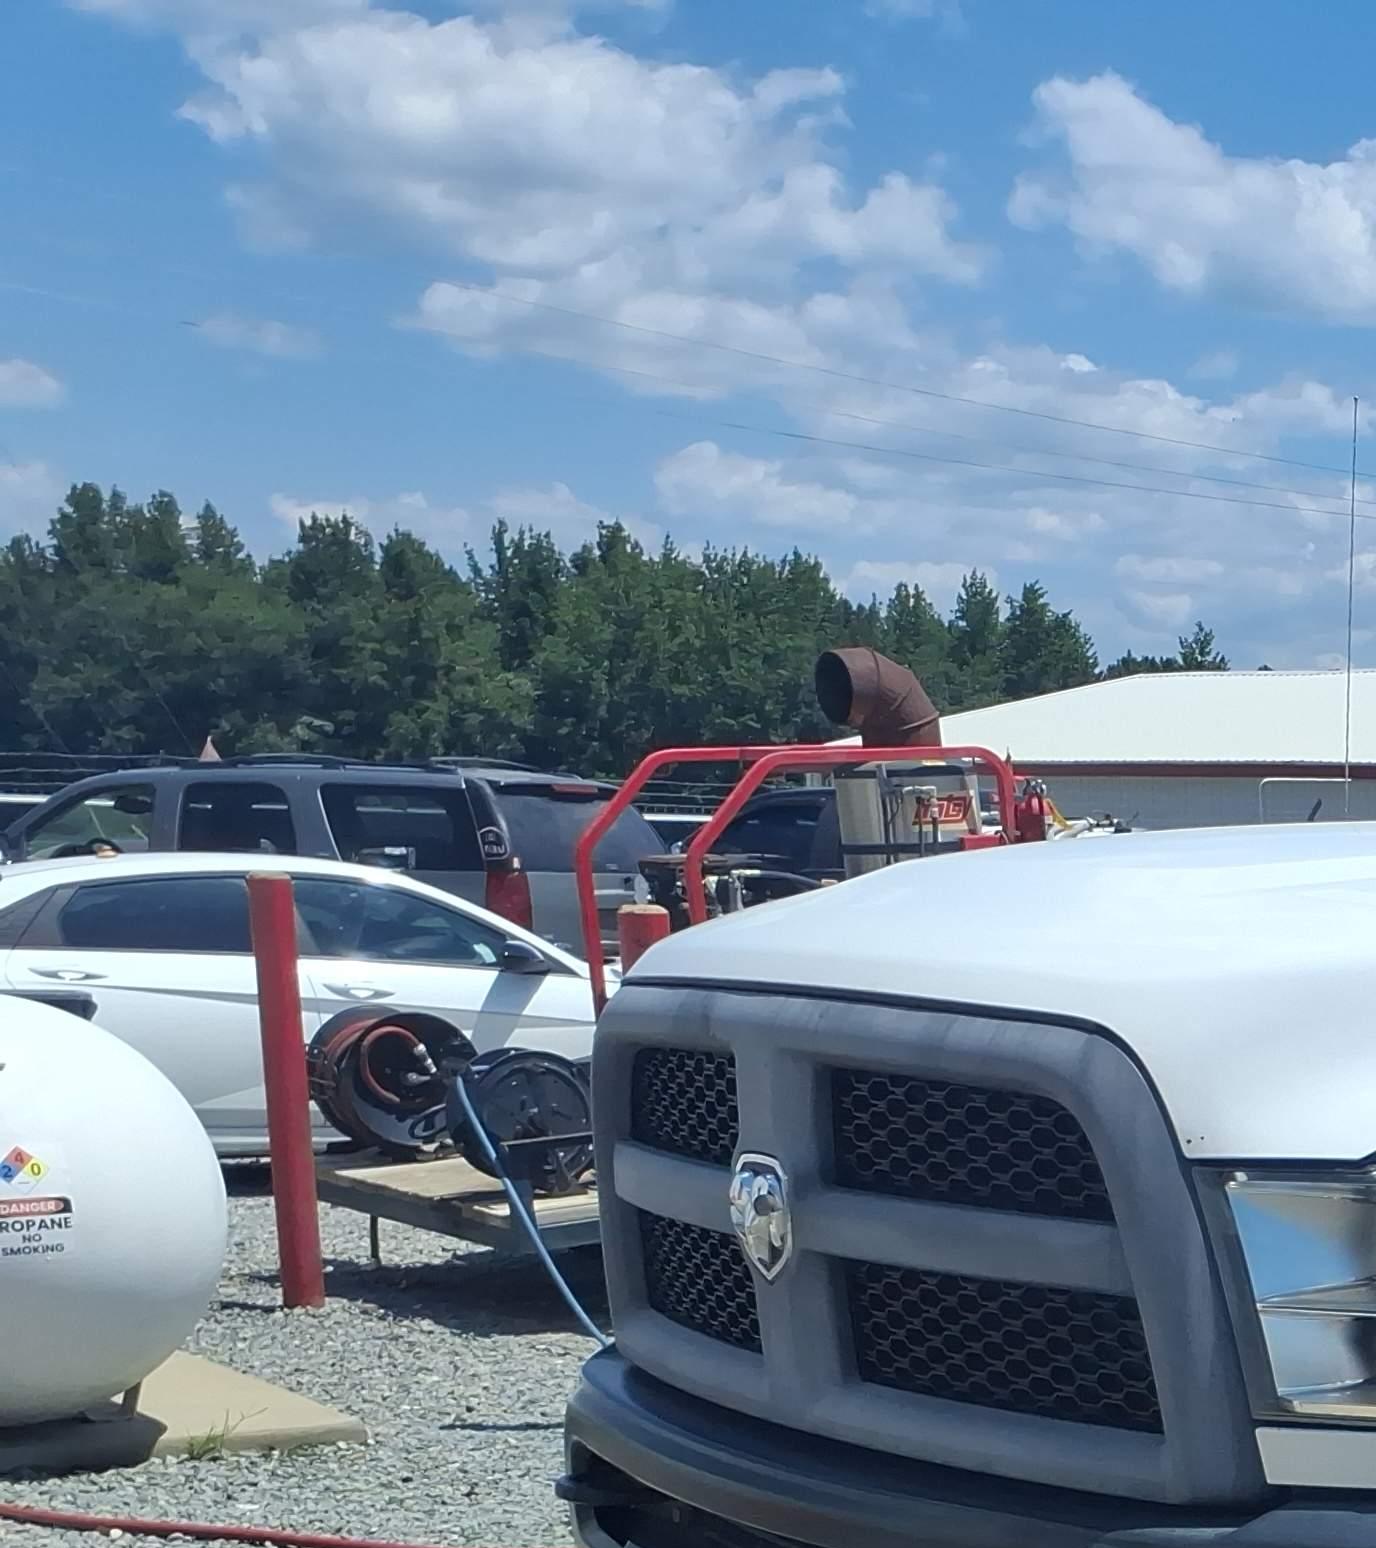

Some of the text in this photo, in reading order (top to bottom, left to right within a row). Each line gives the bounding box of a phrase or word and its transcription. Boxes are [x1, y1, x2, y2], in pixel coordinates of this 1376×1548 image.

[1, 1163, 41, 1178] 2 0
[0, 1200, 56, 1214] DANGER
[22, 1234, 42, 1243] NO
[2, 1243, 64, 1256] SMOKING
